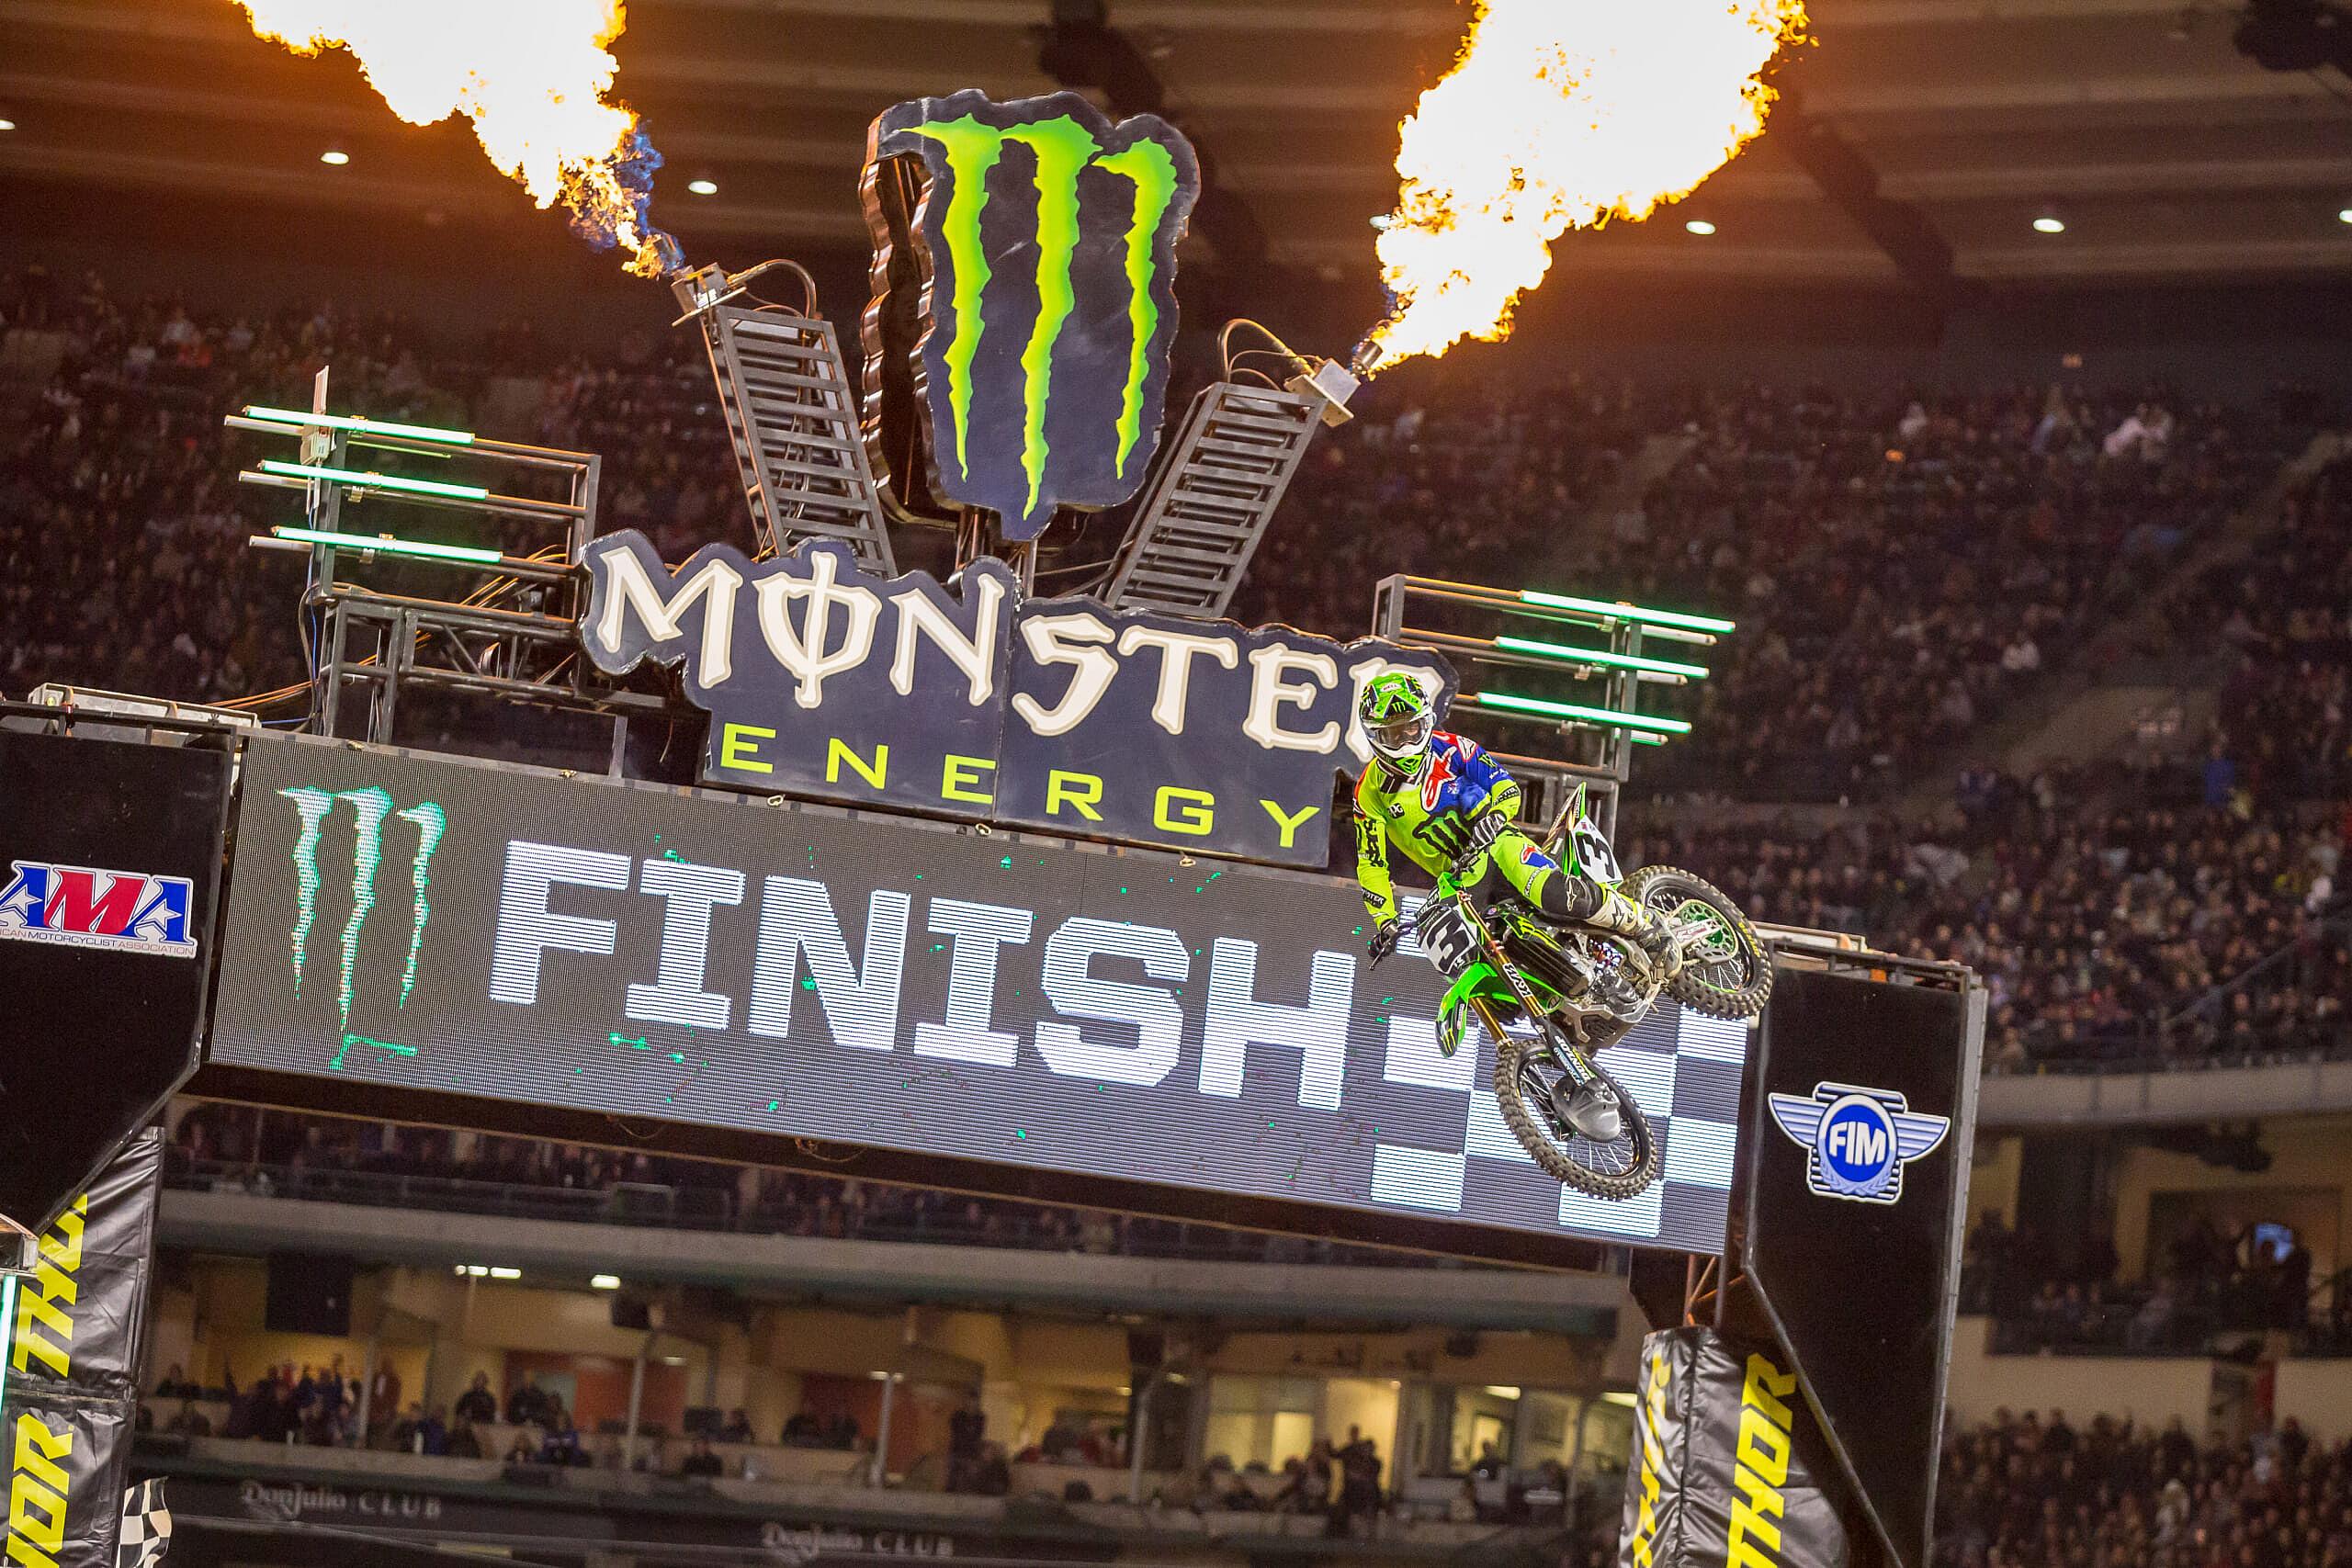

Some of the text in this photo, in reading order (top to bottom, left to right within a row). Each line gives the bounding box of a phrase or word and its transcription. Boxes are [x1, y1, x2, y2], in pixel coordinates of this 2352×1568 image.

[720, 723, 1320, 848] ENERGY
[1575, 830, 1615, 879] 3
[0, 863, 195, 946] AMA
[28, 931, 119, 947] MOTORCYCLIST
[118, 940, 195, 955] ASSOCIATION
[489, 840, 1357, 1111] FINISH
[1829, 1121, 1887, 1167] FIM
[13, 1193, 88, 1378] THO
[358, 1491, 442, 1519] CLUB
[873, 1533, 955, 1558] CLUB
